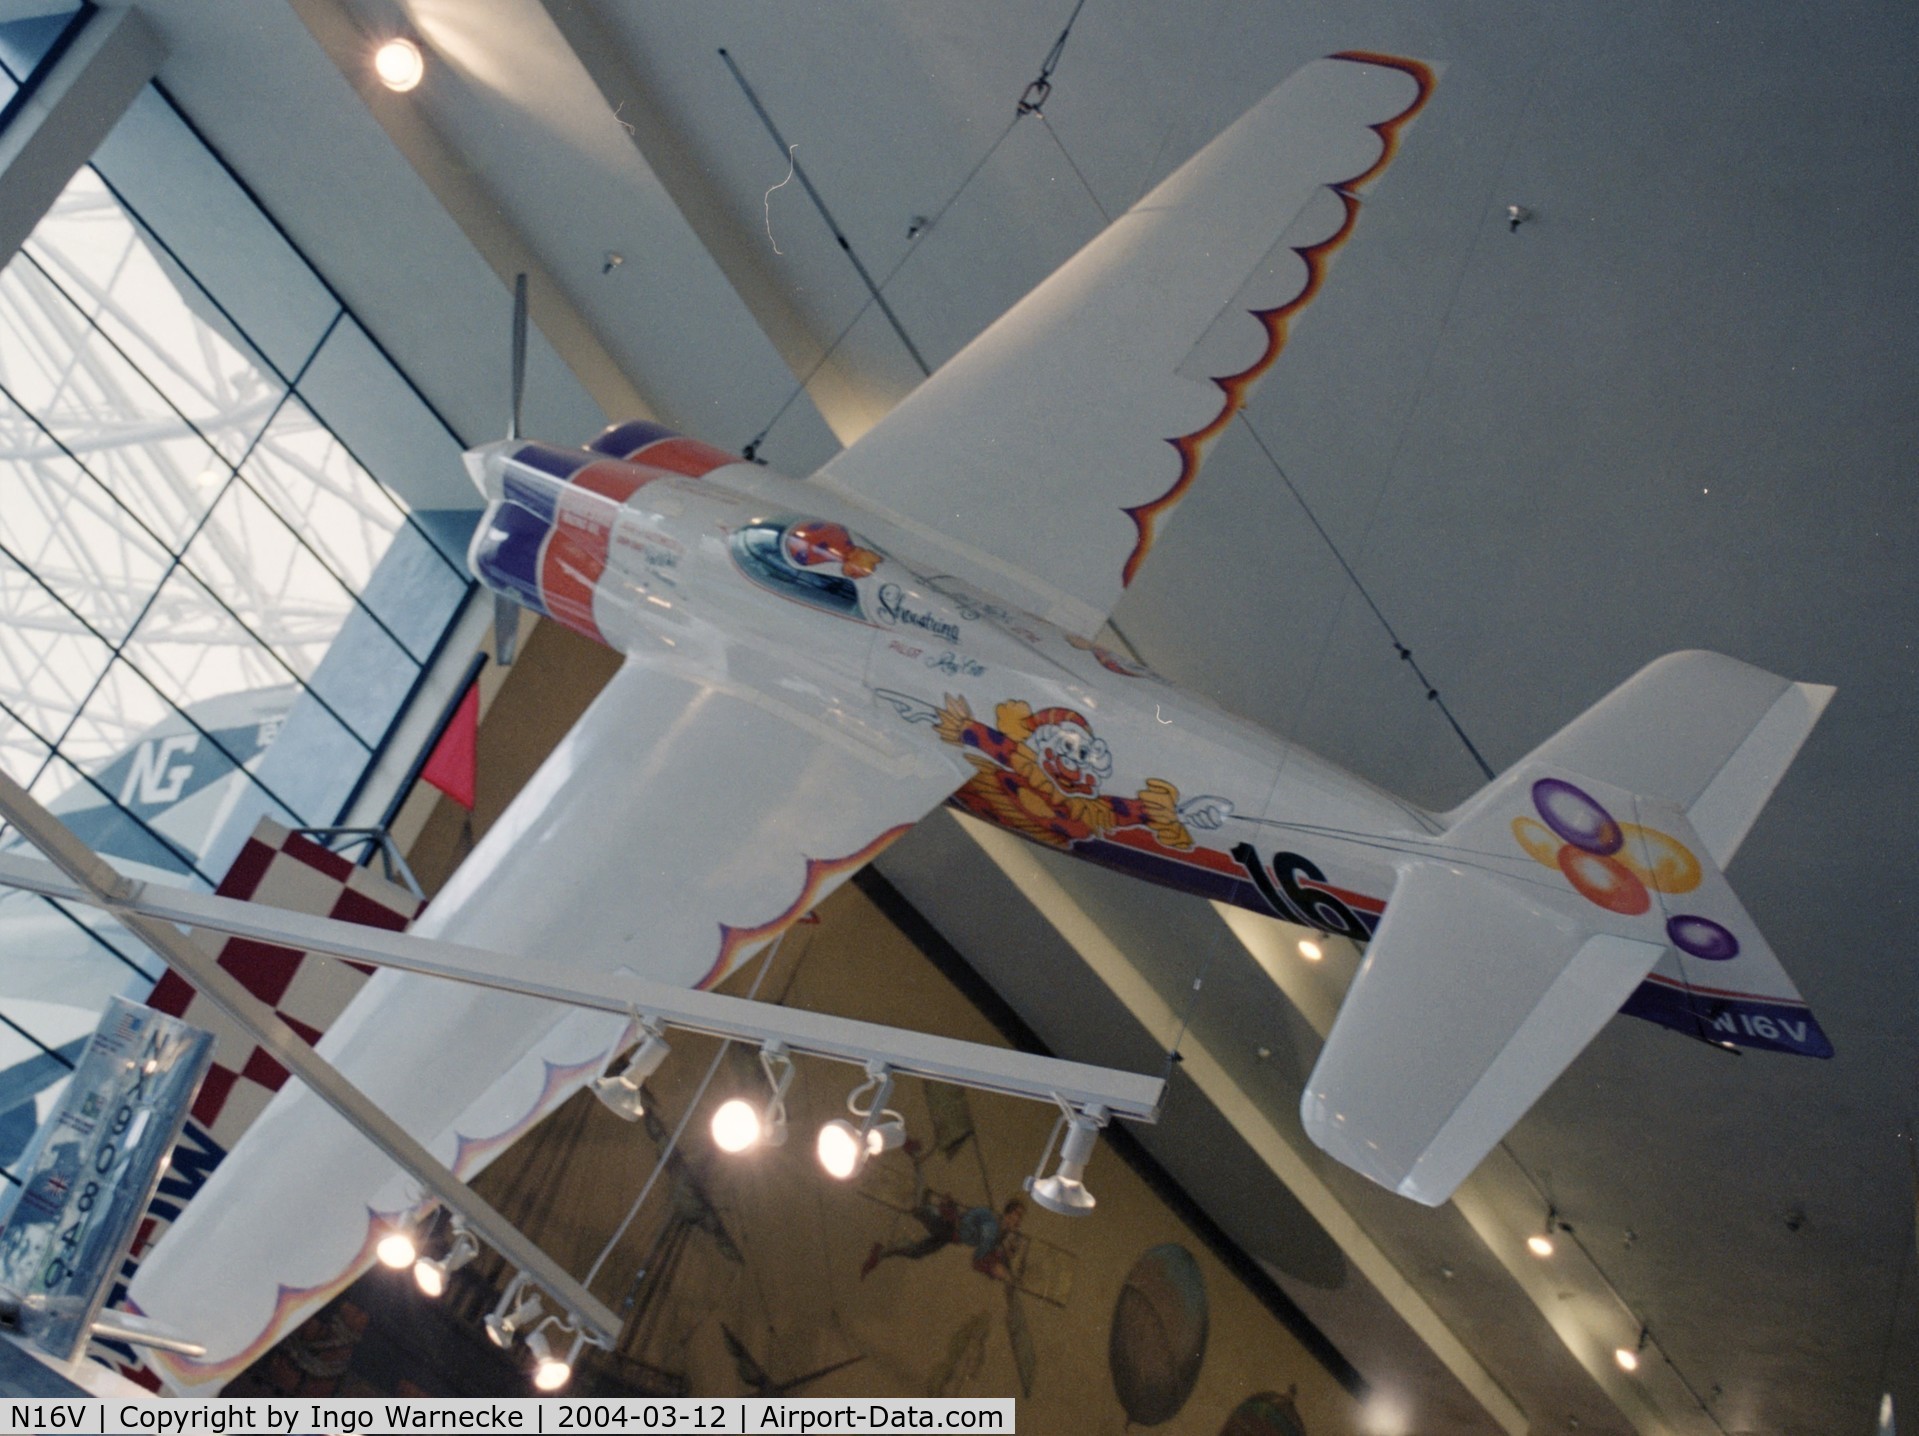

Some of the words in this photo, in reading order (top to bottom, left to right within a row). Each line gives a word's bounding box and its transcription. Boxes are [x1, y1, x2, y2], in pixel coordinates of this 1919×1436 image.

[120, 734, 199, 804] NG
[1230, 842, 1372, 941] 16
[1712, 1011, 1806, 1042] N16V
